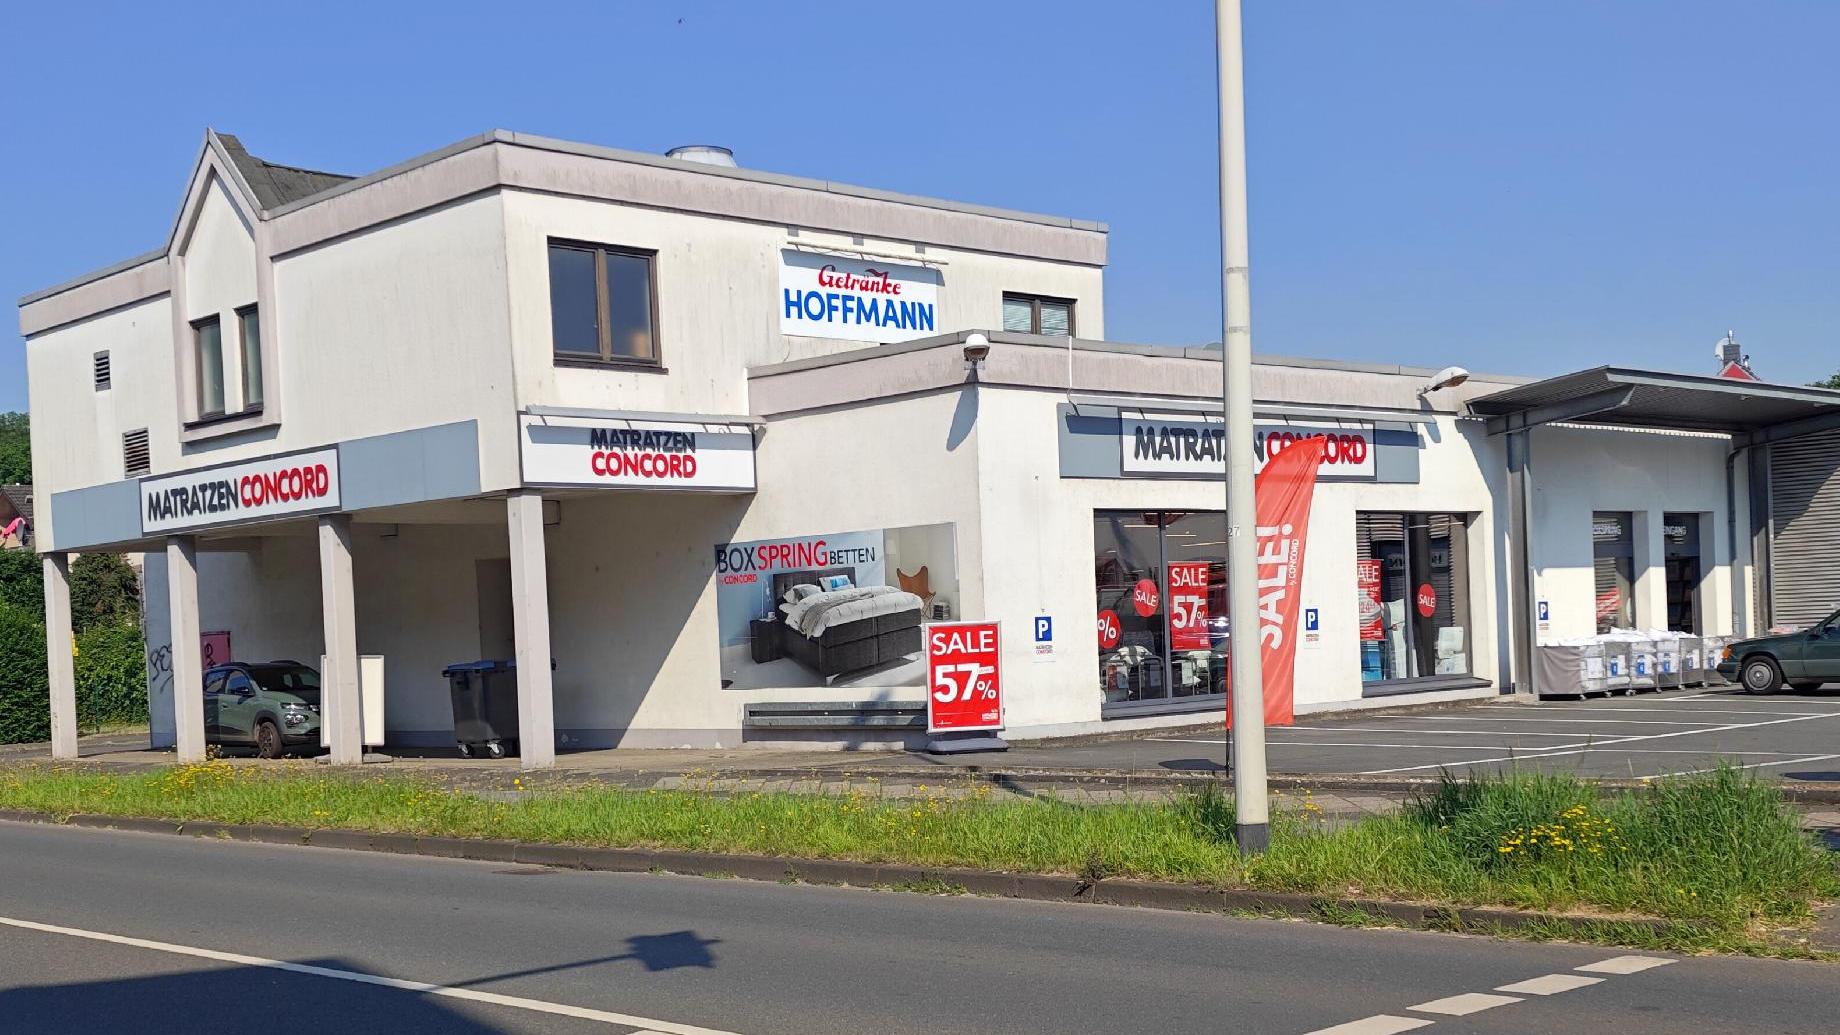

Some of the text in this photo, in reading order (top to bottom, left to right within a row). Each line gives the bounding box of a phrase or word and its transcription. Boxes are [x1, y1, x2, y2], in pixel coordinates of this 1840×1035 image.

[818, 264, 901, 295] Getränke
[784, 288, 933, 331] HOFFMANN
[590, 428, 696, 453] MATRATZEN
[1134, 426, 1263, 463] MATRATN
[592, 451, 696, 478] CONCORD
[149, 464, 329, 522] MATRATZEN CONCORD
[1288, 539, 1300, 578] CONCORD
[724, 573, 757, 584] CONCORD
[1172, 567, 1207, 586] SALE
[1135, 590, 1157, 607] SALE
[1419, 594, 1435, 608] SALE
[1038, 620, 1048, 639] P
[1308, 611, 1316, 627] P
[932, 630, 995, 656] SALE
